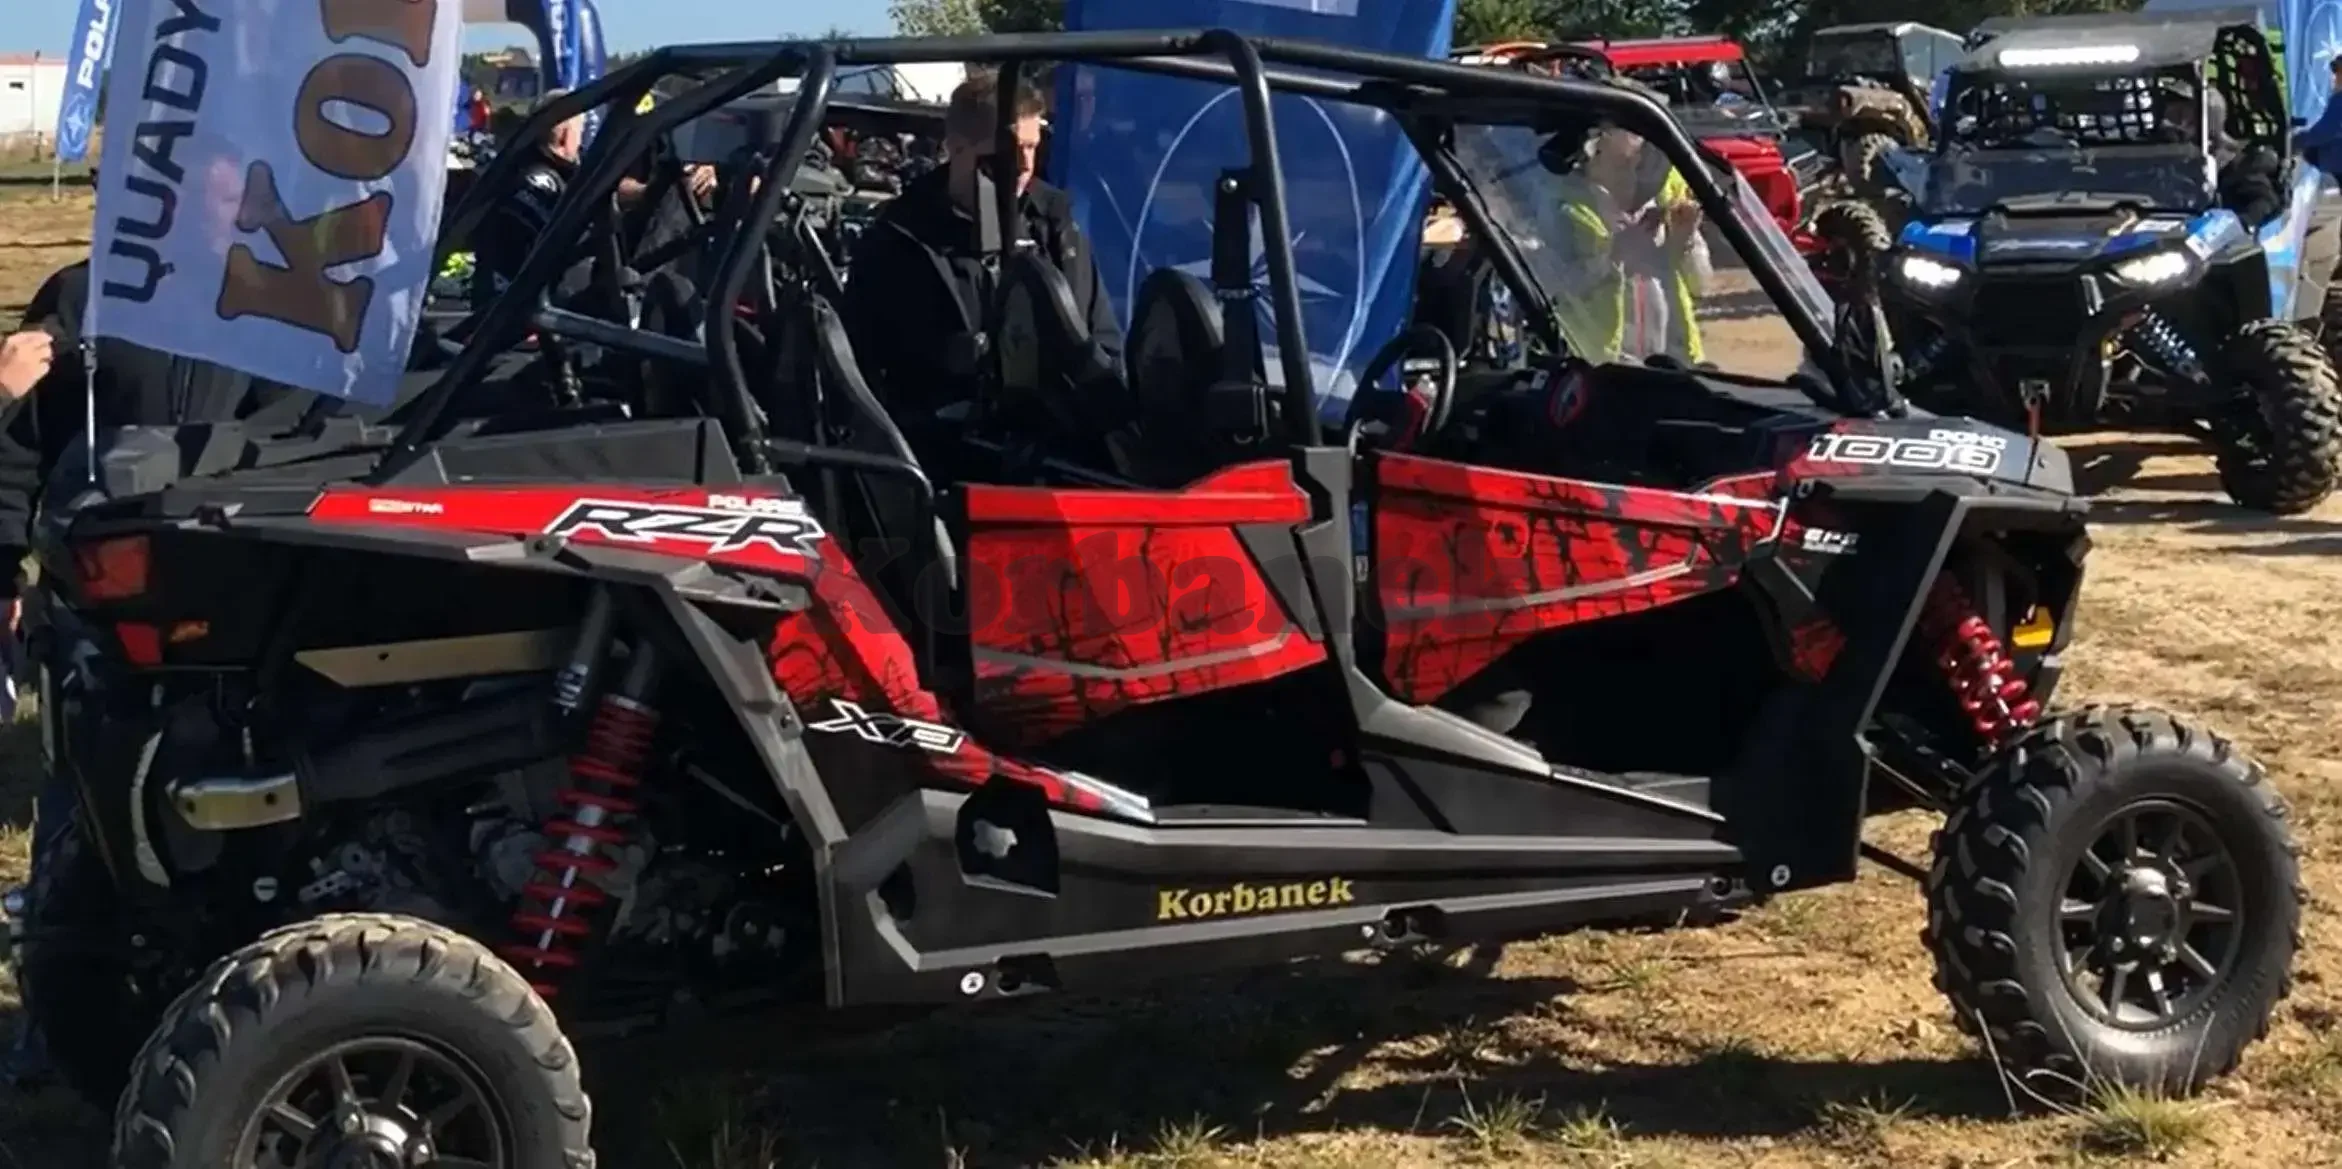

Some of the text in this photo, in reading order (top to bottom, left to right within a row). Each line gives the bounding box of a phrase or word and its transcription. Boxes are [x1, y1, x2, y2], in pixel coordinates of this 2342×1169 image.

[1806, 434, 2000, 474] 1000
[543, 498, 825, 559] RZR
[1157, 876, 1355, 920] Korbanek
